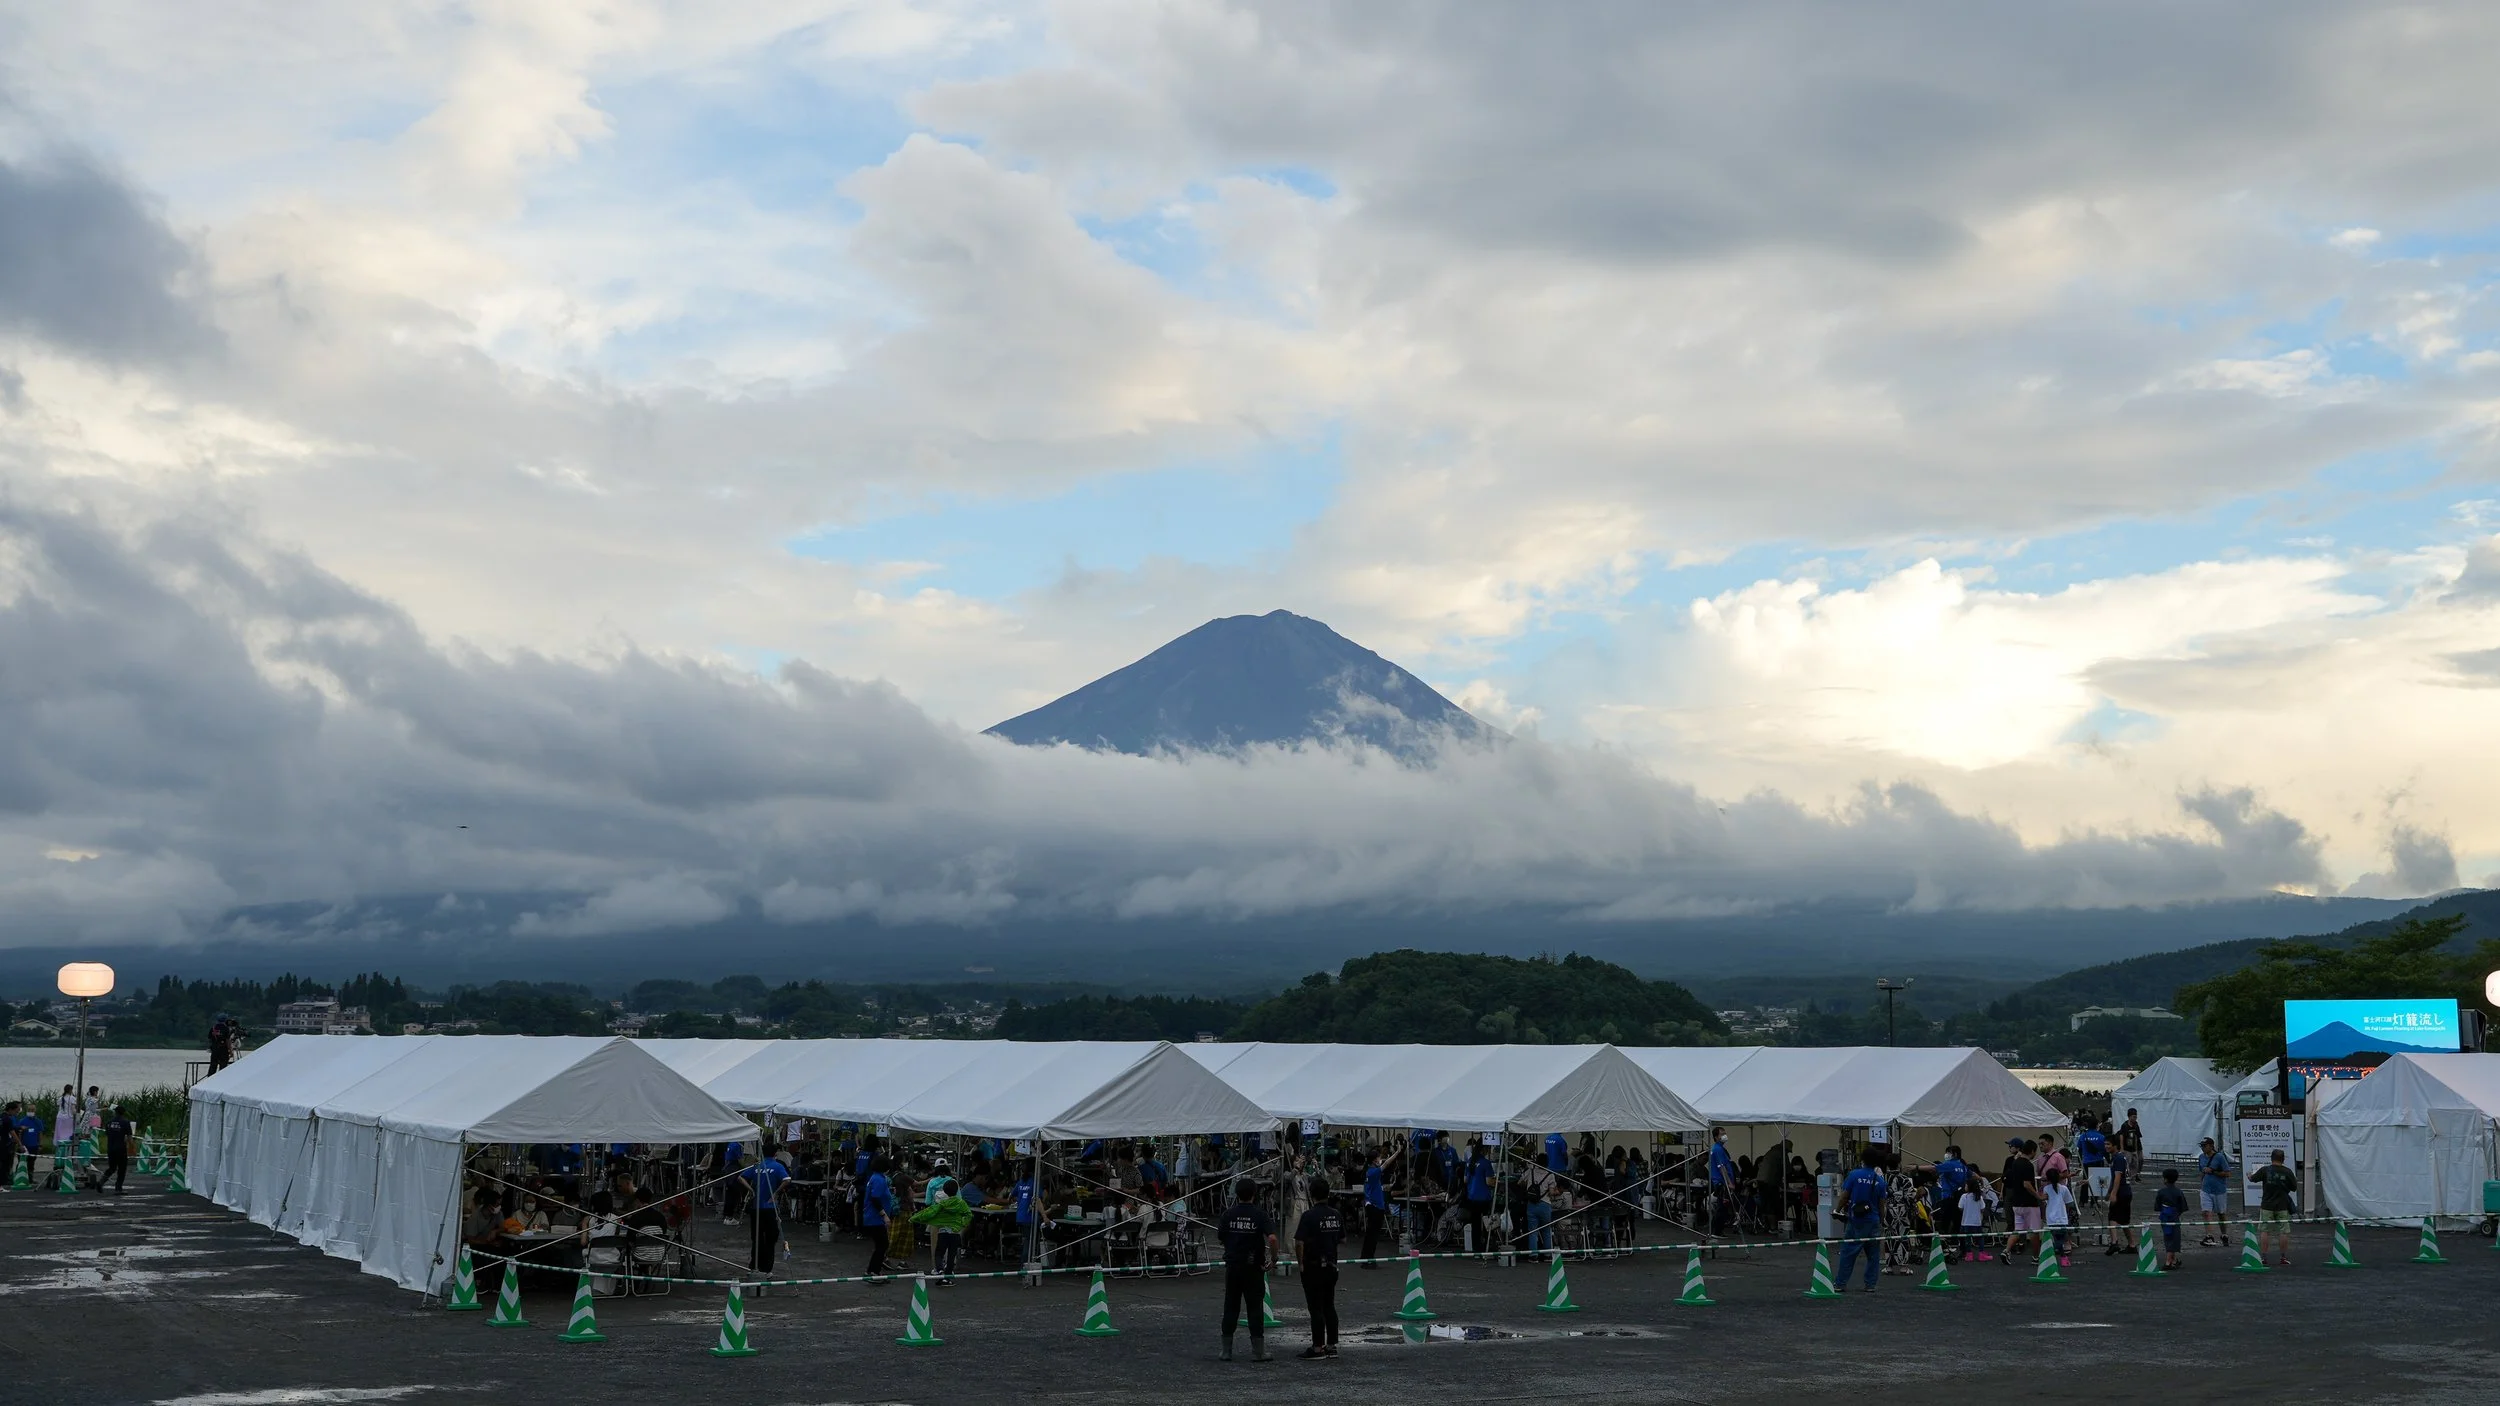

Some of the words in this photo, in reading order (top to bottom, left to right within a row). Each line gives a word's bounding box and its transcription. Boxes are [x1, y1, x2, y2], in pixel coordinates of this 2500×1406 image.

[2393, 1013, 2444, 1026] 灯籠流し
[1304, 1121, 1316, 1130] 2-2
[1871, 1129, 1882, 1139] 1-1
